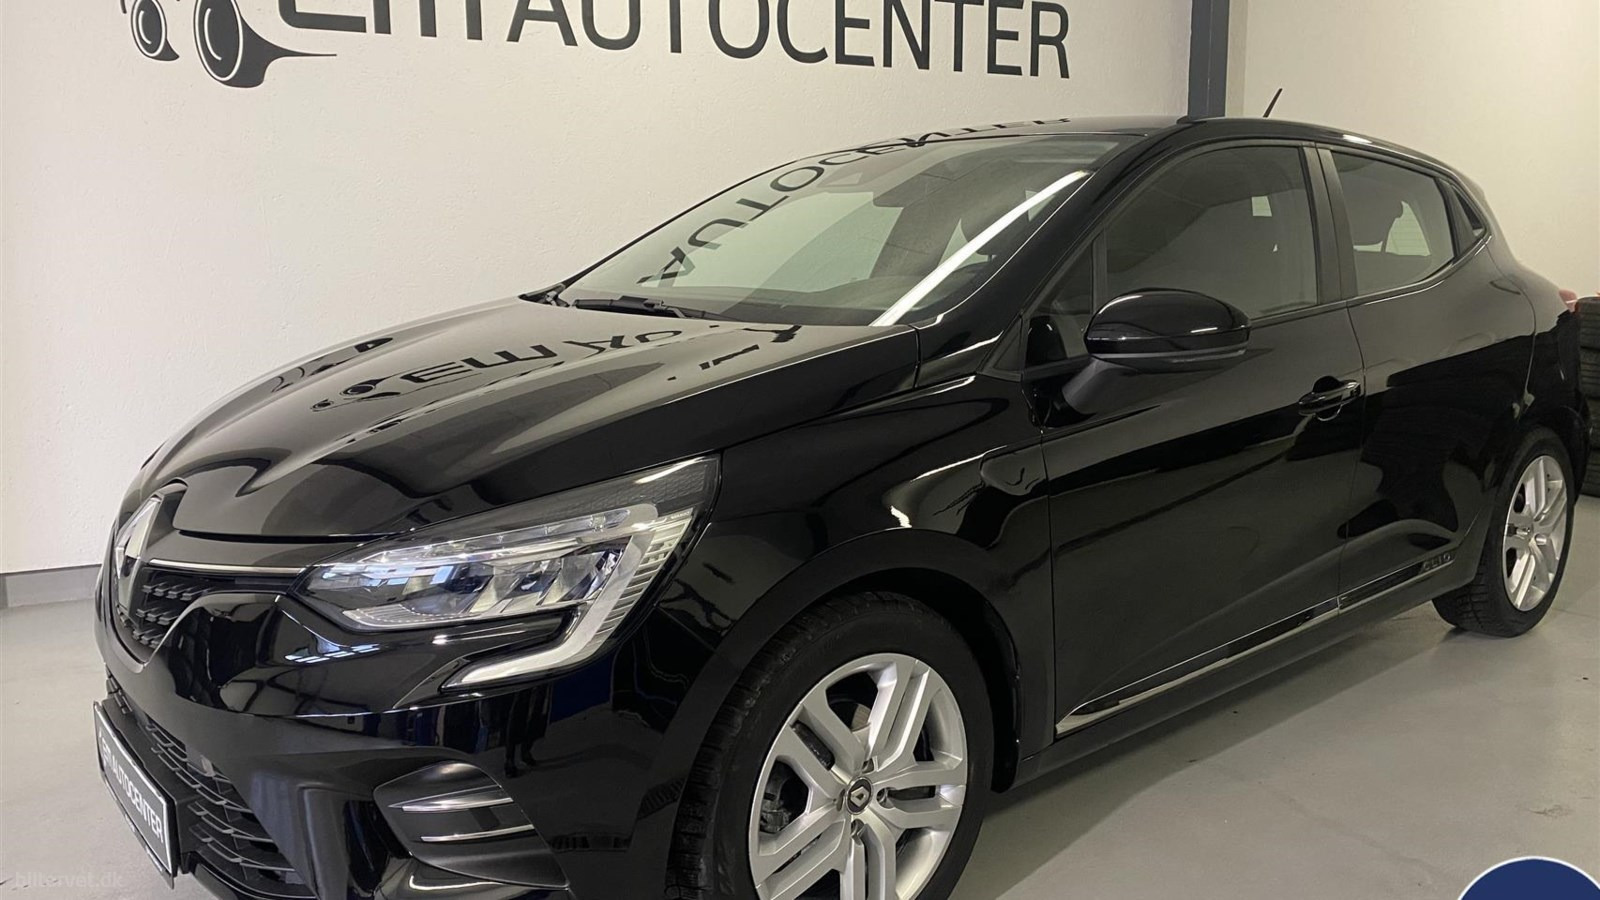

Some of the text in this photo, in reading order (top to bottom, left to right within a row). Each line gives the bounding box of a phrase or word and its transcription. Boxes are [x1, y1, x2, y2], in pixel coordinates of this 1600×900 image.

[505, 0, 1070, 79] AUTOCENTER
[1423, 552, 1451, 571] CLIO
[112, 754, 164, 844] AUTOCENTER
